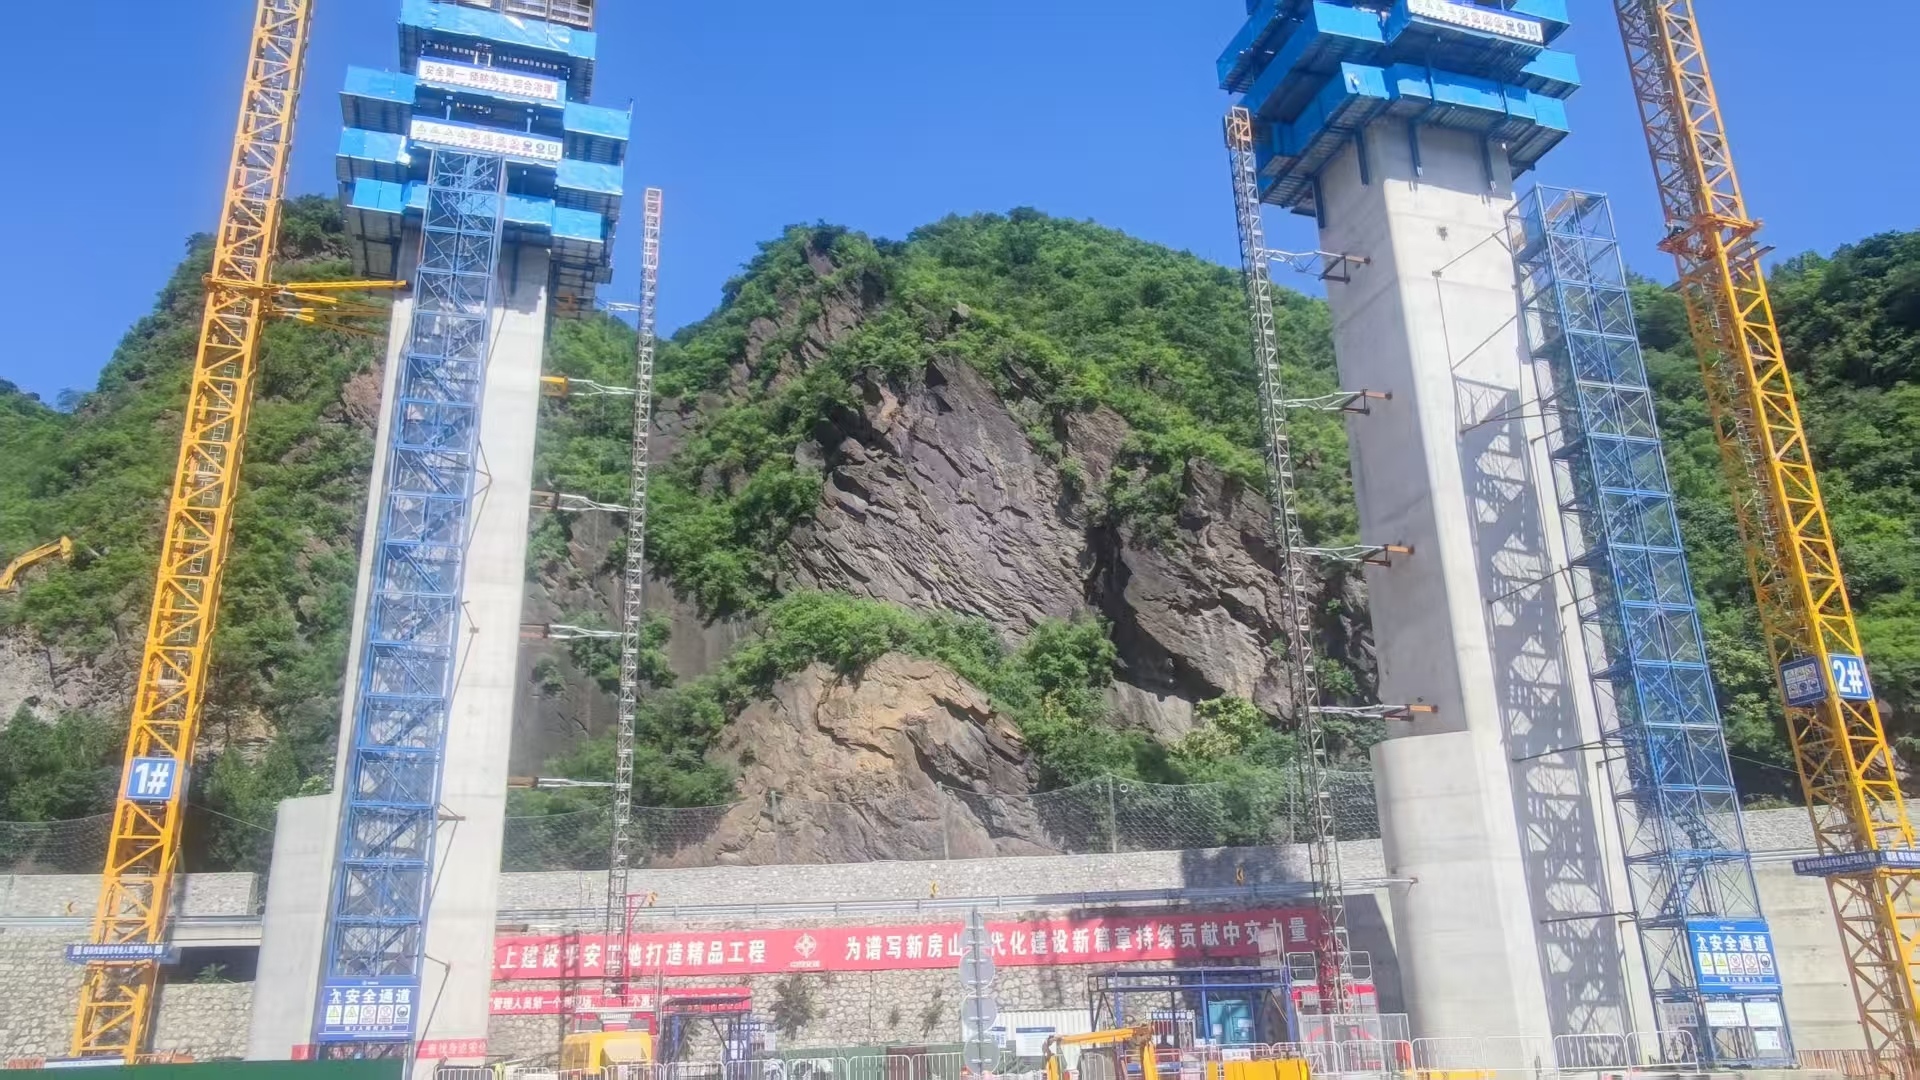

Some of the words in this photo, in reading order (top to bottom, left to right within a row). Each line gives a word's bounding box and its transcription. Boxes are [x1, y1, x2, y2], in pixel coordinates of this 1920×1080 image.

[1833, 659, 1864, 694] 2#
[135, 762, 169, 794] 1#
[492, 937, 766, 970] 上建设平安工地打造精品工程
[843, 915, 1309, 961] 为谱写新房山代化建设新篇章持续贡献中交力量
[1709, 934, 1769, 952] 安全通道
[345, 988, 412, 1004] 安全通道
